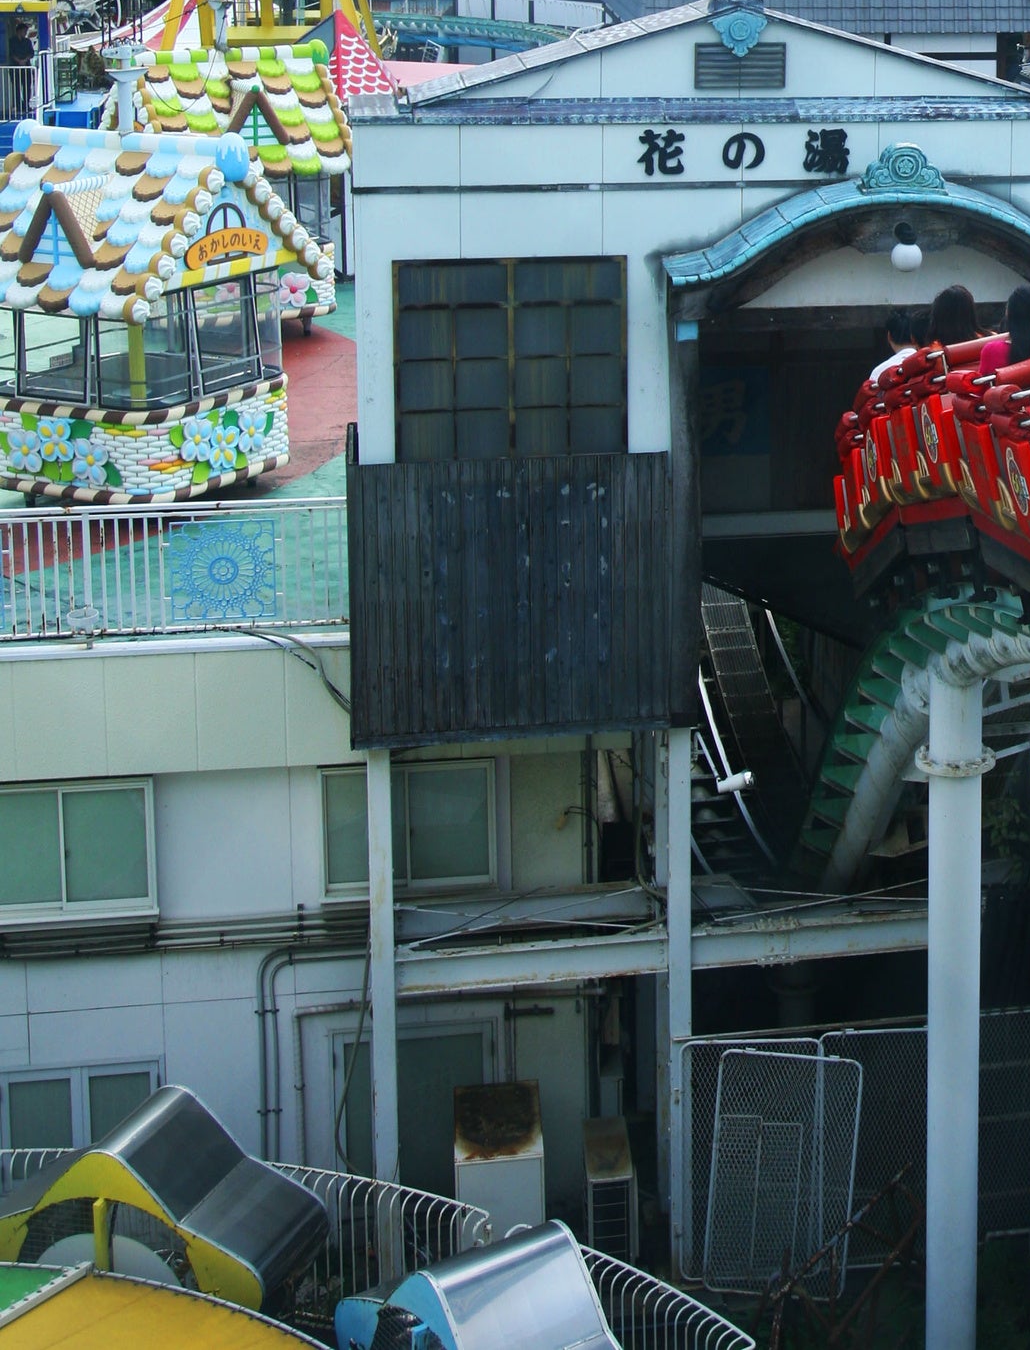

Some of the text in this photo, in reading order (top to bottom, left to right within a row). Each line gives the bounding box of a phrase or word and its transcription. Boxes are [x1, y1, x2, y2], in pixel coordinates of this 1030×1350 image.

[637, 128, 850, 176] 花の湯
[198, 233, 262, 262] おかしのいえ
